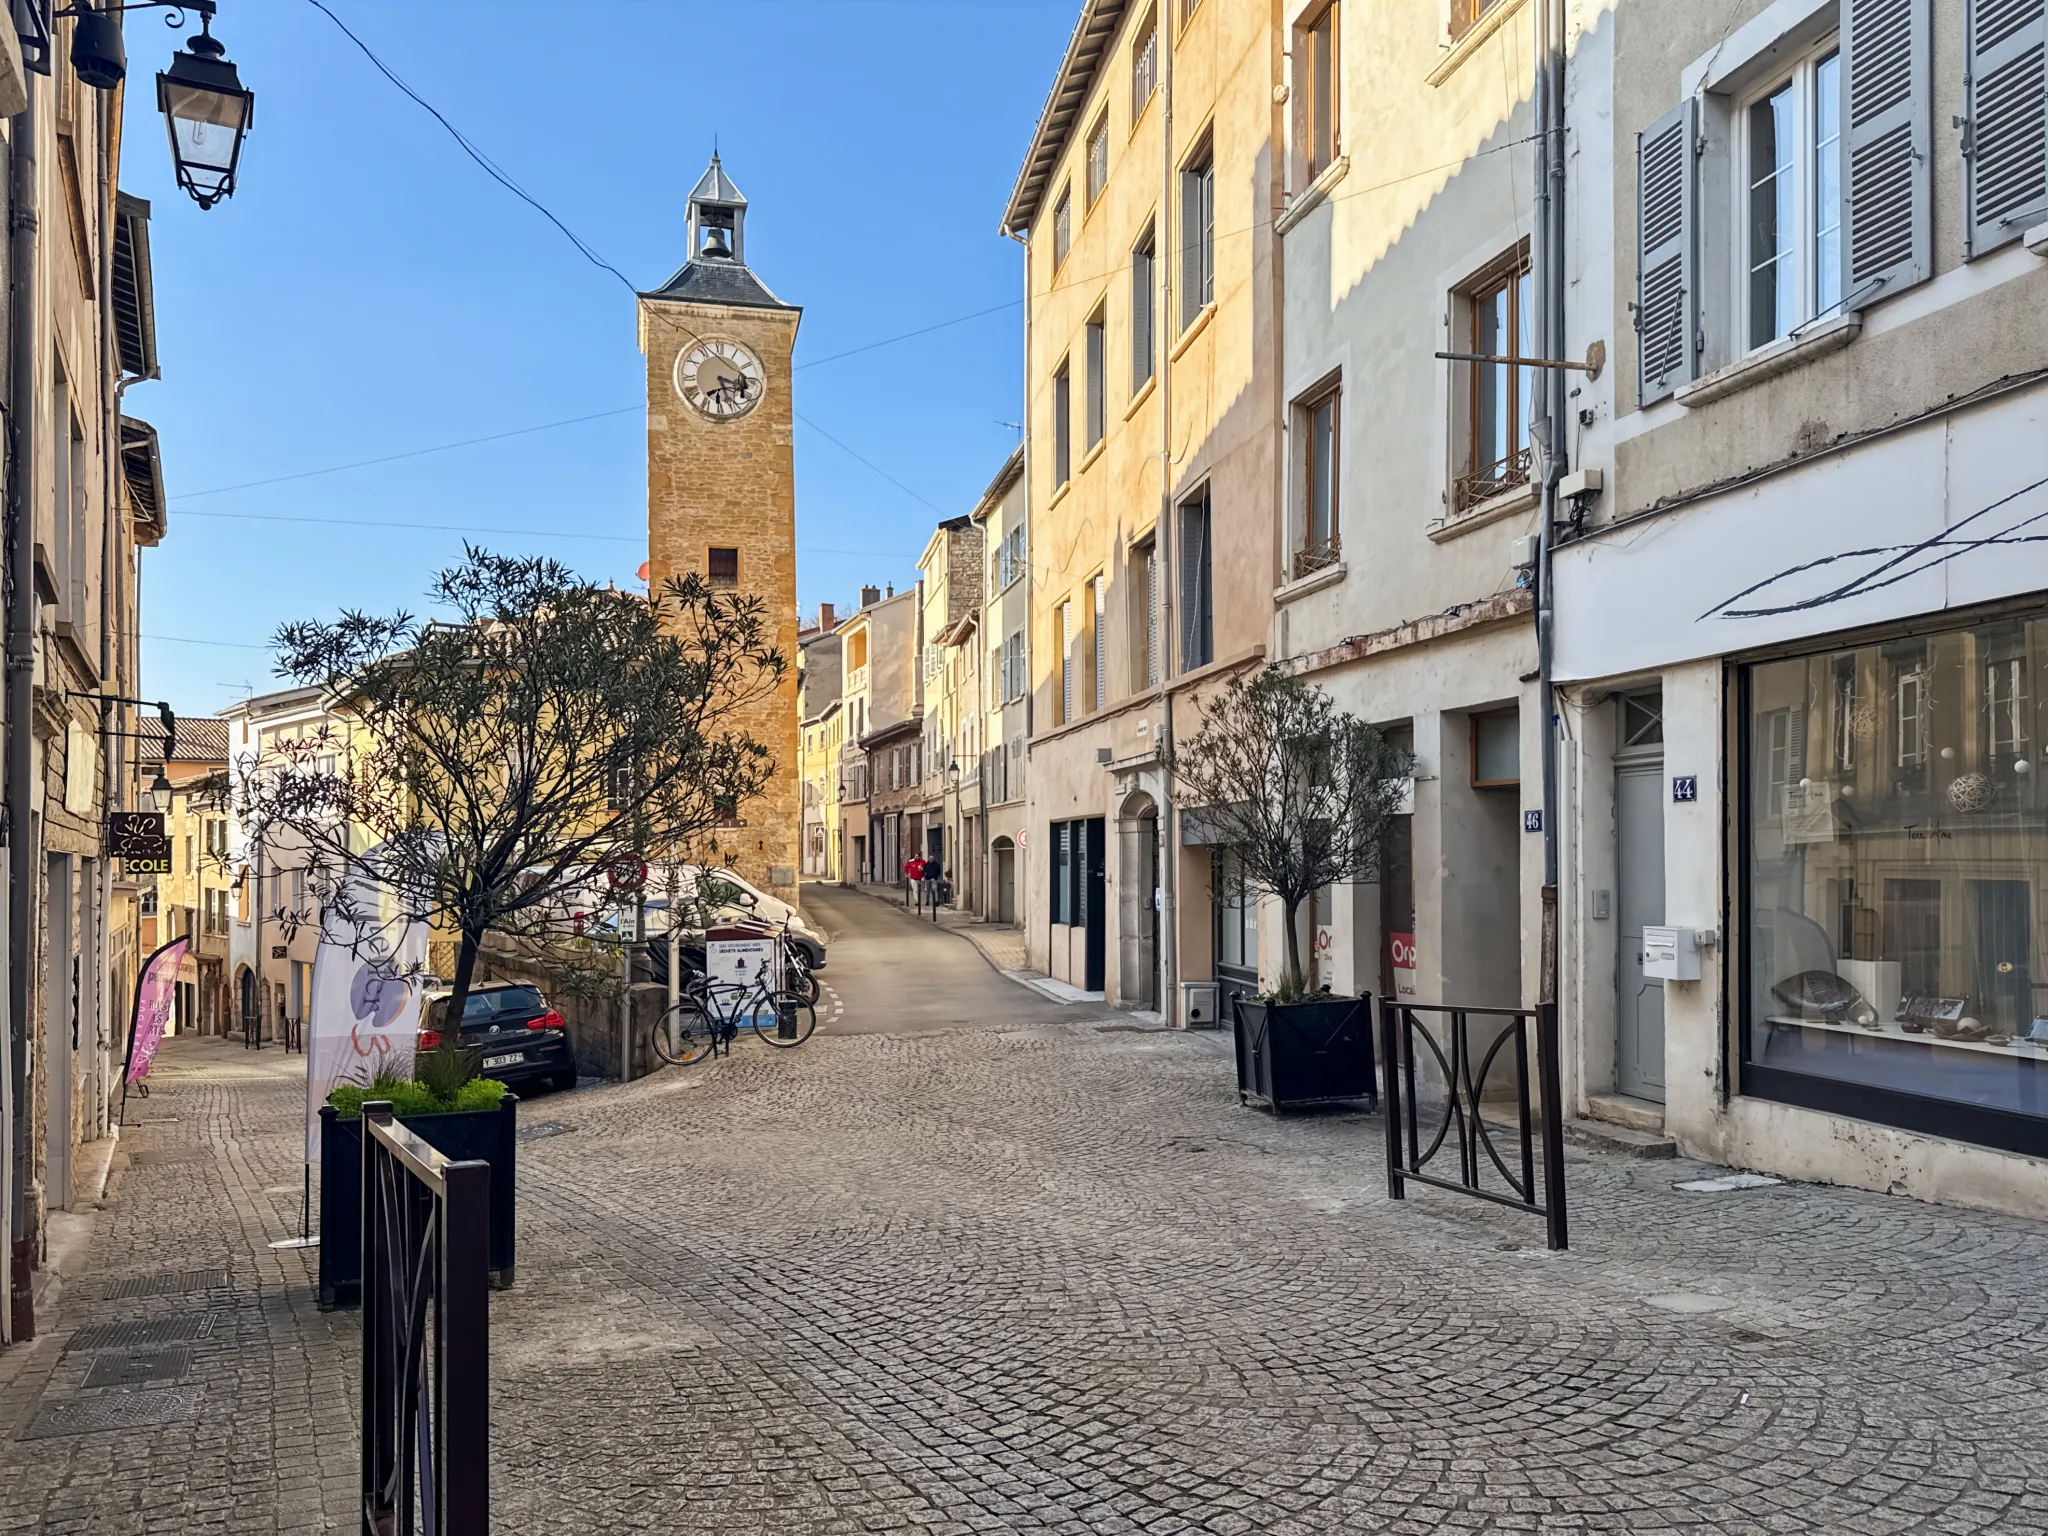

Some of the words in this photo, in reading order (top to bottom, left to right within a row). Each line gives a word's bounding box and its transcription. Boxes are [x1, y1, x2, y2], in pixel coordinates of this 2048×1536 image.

[1674, 779, 1693, 799] 44
[1526, 813, 1539, 830] 46
[1392, 939, 1416, 968] Orp
[148, 1025, 166, 1036] RTS
